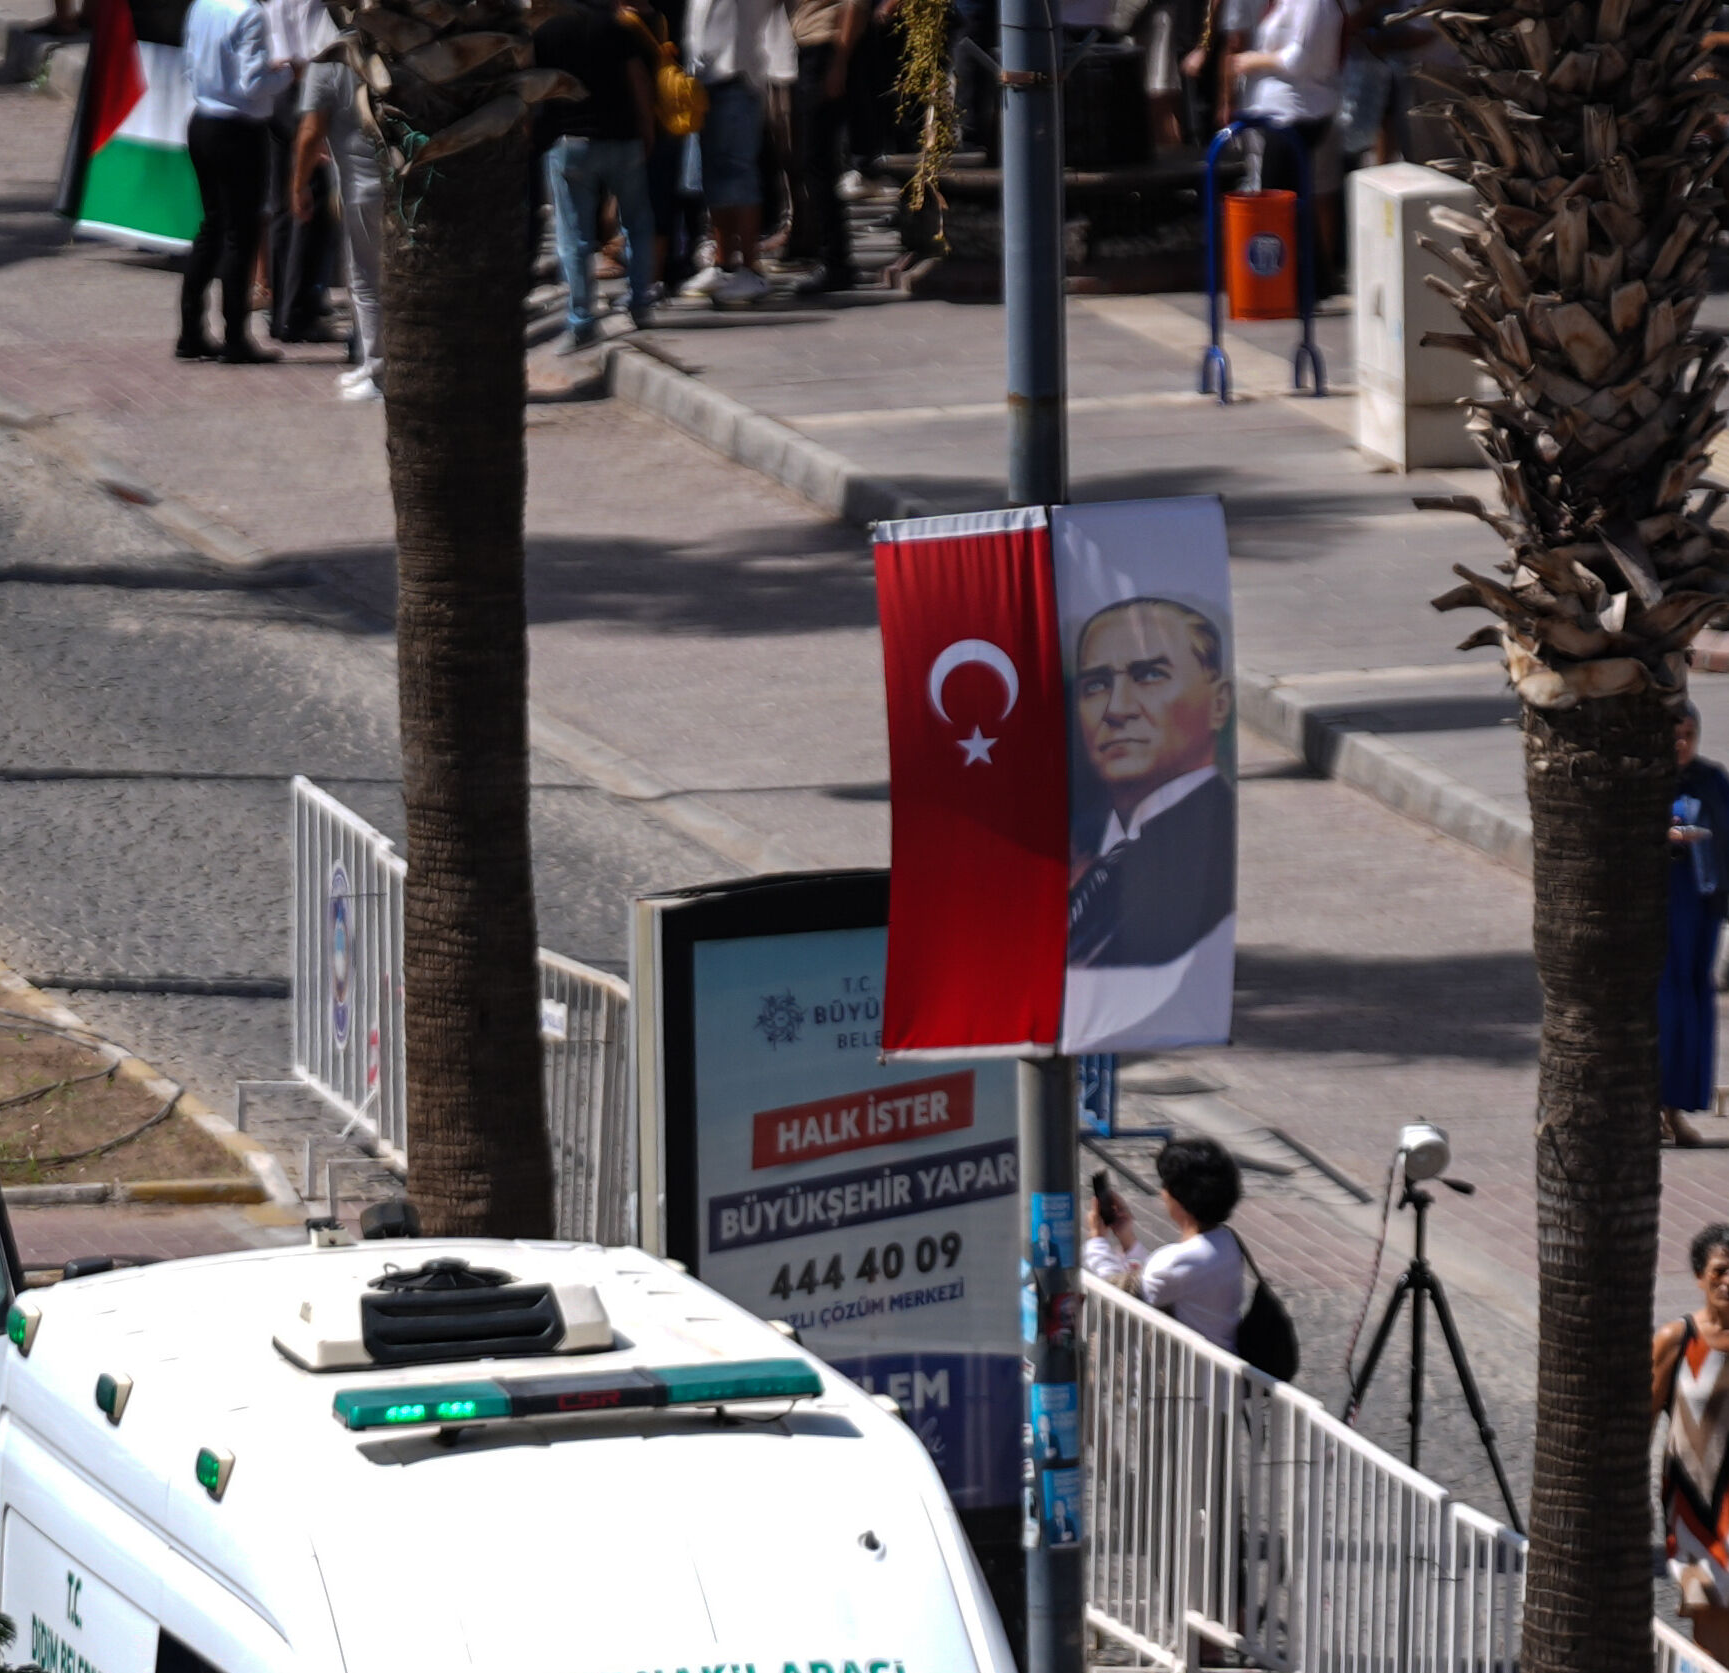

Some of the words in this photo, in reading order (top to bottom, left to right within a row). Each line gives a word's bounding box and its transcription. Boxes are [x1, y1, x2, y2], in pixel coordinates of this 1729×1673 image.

[777, 1106, 861, 1153] HALK
[867, 1089, 949, 1135] İSTER
[720, 1167, 912, 1240] BÜYÜKŞEHİR
[917, 1152, 1016, 1200] YAPAR
[769, 1253, 845, 1300] 444
[856, 1241, 905, 1283] 40
[916, 1231, 962, 1273] 09
[889, 1277, 965, 1311] MERKEZİ
